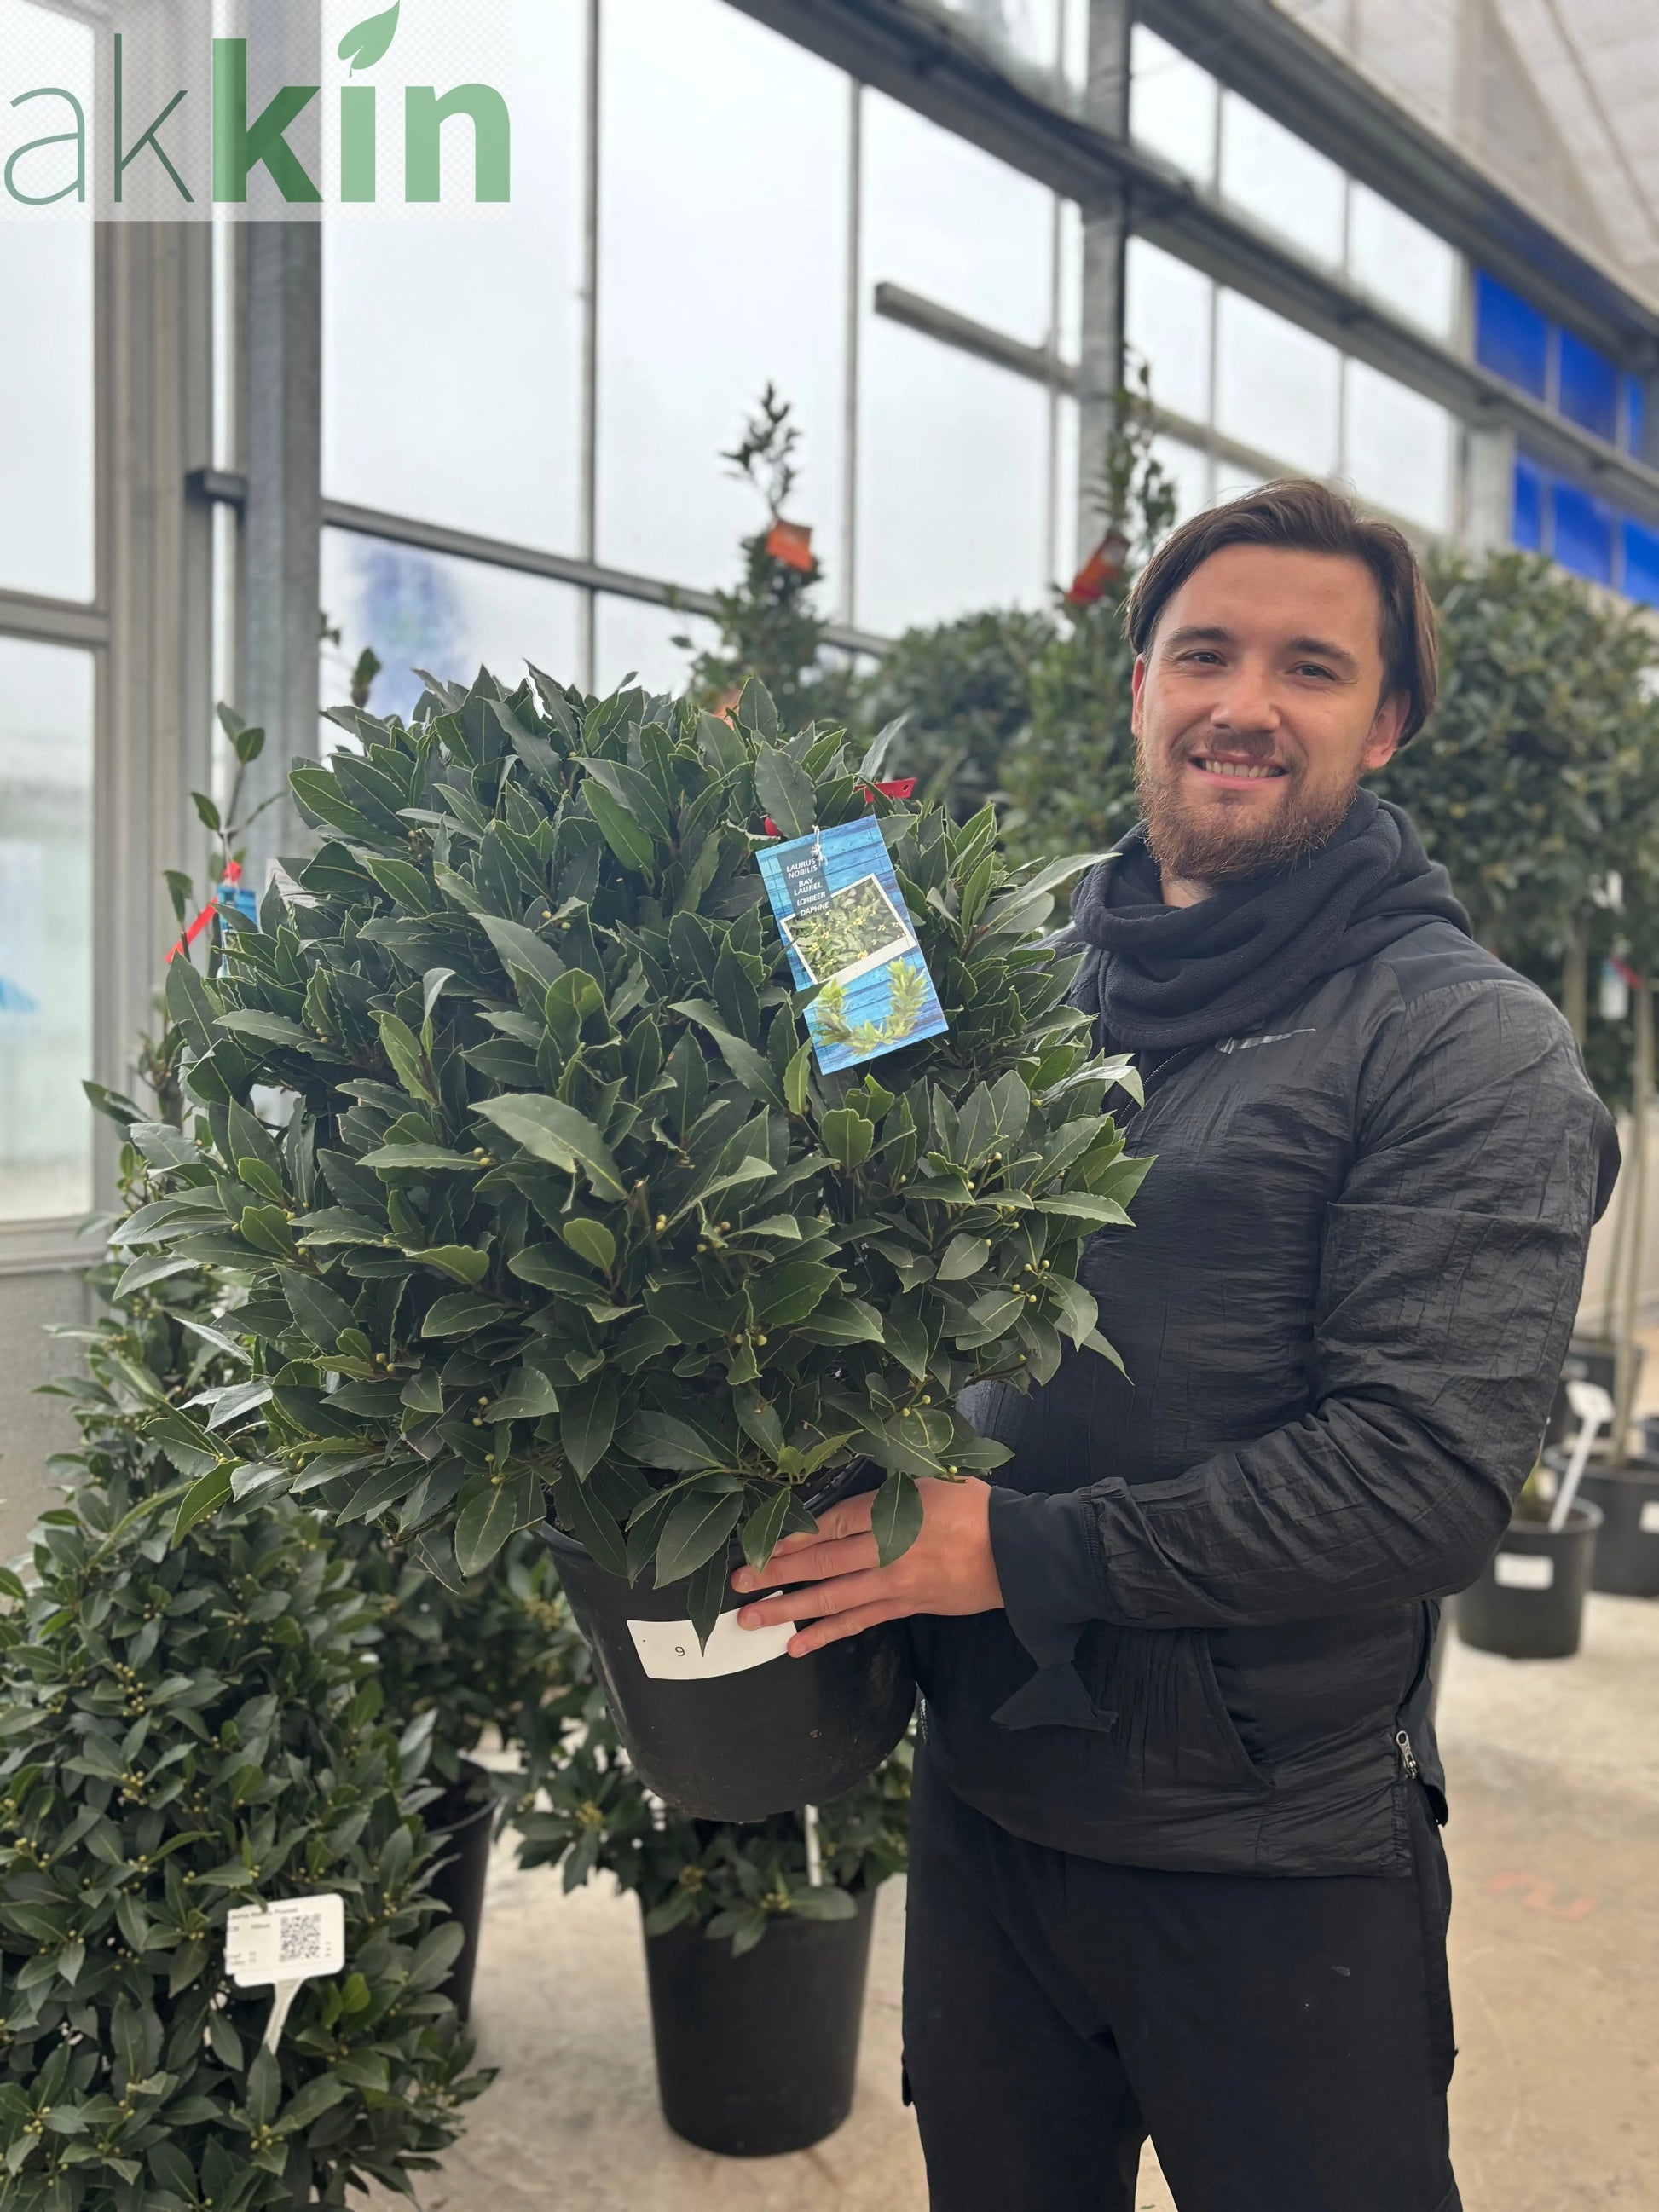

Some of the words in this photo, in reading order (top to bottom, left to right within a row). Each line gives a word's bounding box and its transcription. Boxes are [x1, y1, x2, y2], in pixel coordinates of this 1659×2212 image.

[787, 858, 816, 872] LAURUS
[789, 865, 818, 879] NOBILIS
[794, 882, 822, 896] LAUREL
[799, 877, 813, 887] BAY
[797, 892, 826, 906] LORBEER
[800, 902, 830, 916] DAPHNE
[675, 1646, 685, 1656] 9
